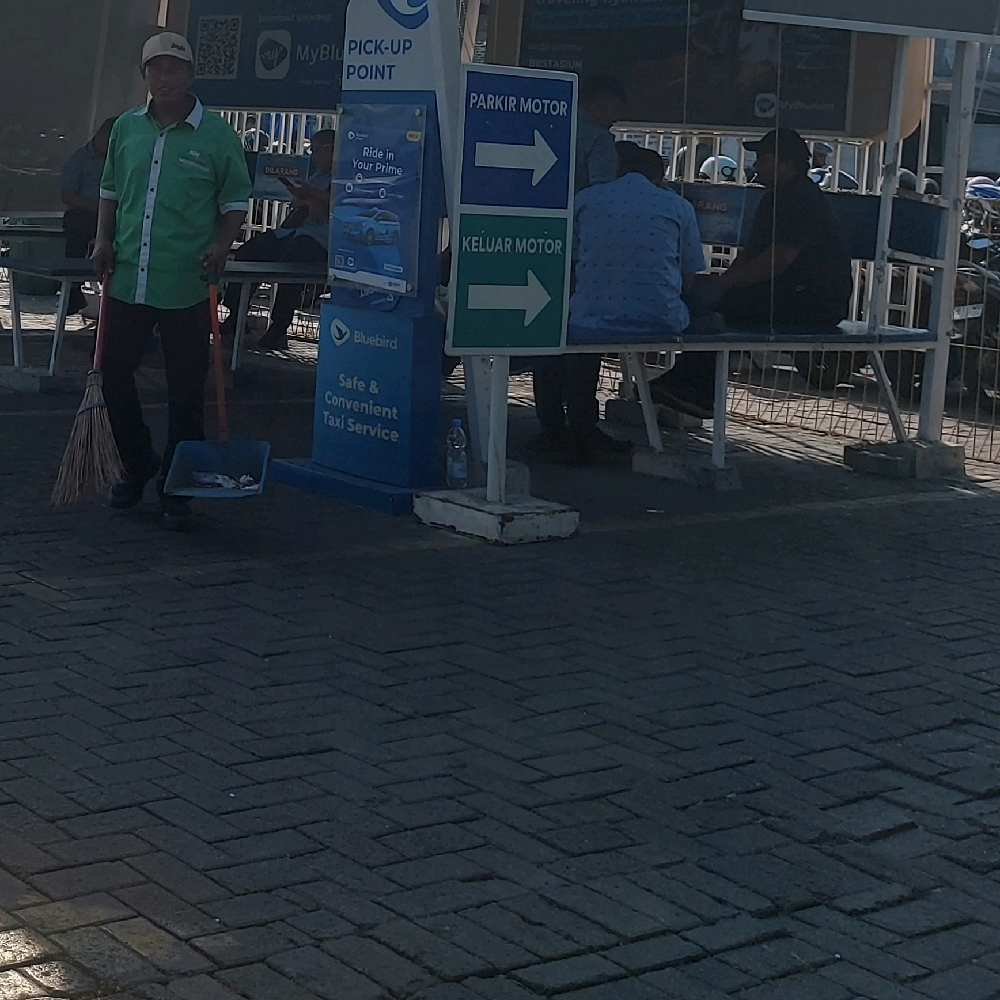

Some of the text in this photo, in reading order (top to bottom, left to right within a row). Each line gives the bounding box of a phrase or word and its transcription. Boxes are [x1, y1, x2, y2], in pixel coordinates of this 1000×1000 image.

[348, 39, 412, 55] PICK-UP
[346, 64, 395, 80] POINT
[469, 93, 568, 116] PARKIR MOTOR
[362, 146, 395, 161] Ride in
[265, 166, 299, 176] DILARANG
[352, 157, 403, 175] Your Prime
[462, 236, 563, 255] KELUAR MOTOR
[353, 330, 398, 350] Bluebird
[338, 373, 379, 394] Safe &
[324, 390, 399, 420] Convenient
[322, 411, 400, 442] Taxi Service
